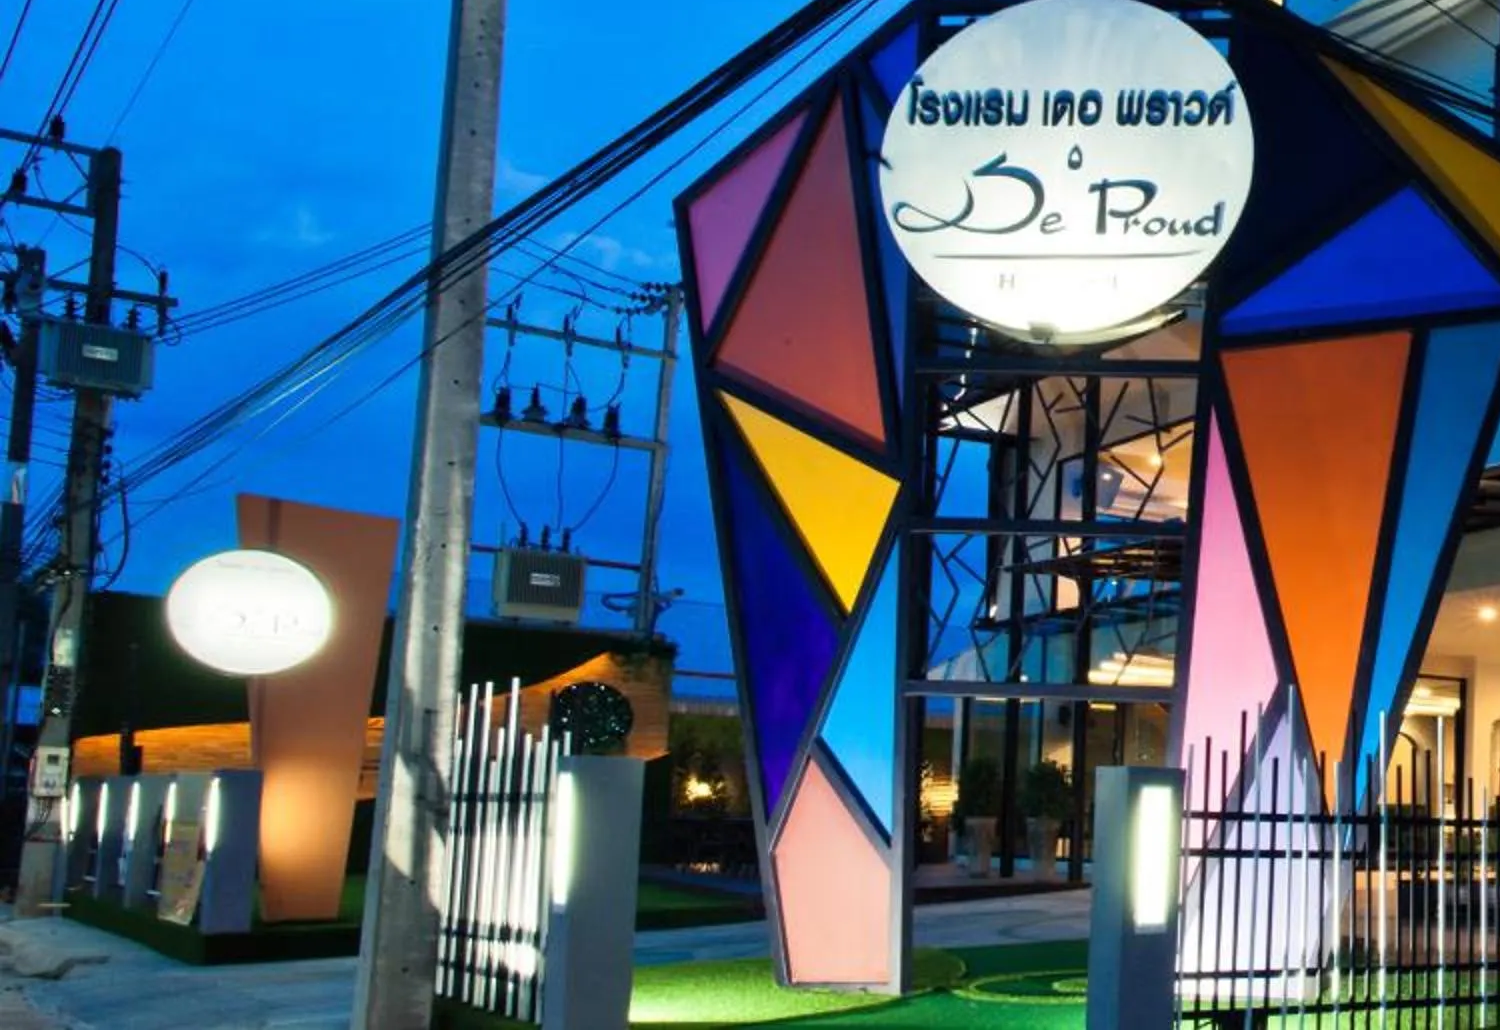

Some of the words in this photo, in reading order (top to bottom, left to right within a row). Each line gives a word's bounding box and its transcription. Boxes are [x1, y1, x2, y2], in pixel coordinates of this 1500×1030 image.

[907, 74, 1029, 127] โรงแรม
[1041, 88, 1103, 127] เดอ
[1115, 80, 1236, 127] พราวด์
[893, 152, 1066, 235] De
[1087, 176, 1226, 237] Proud
